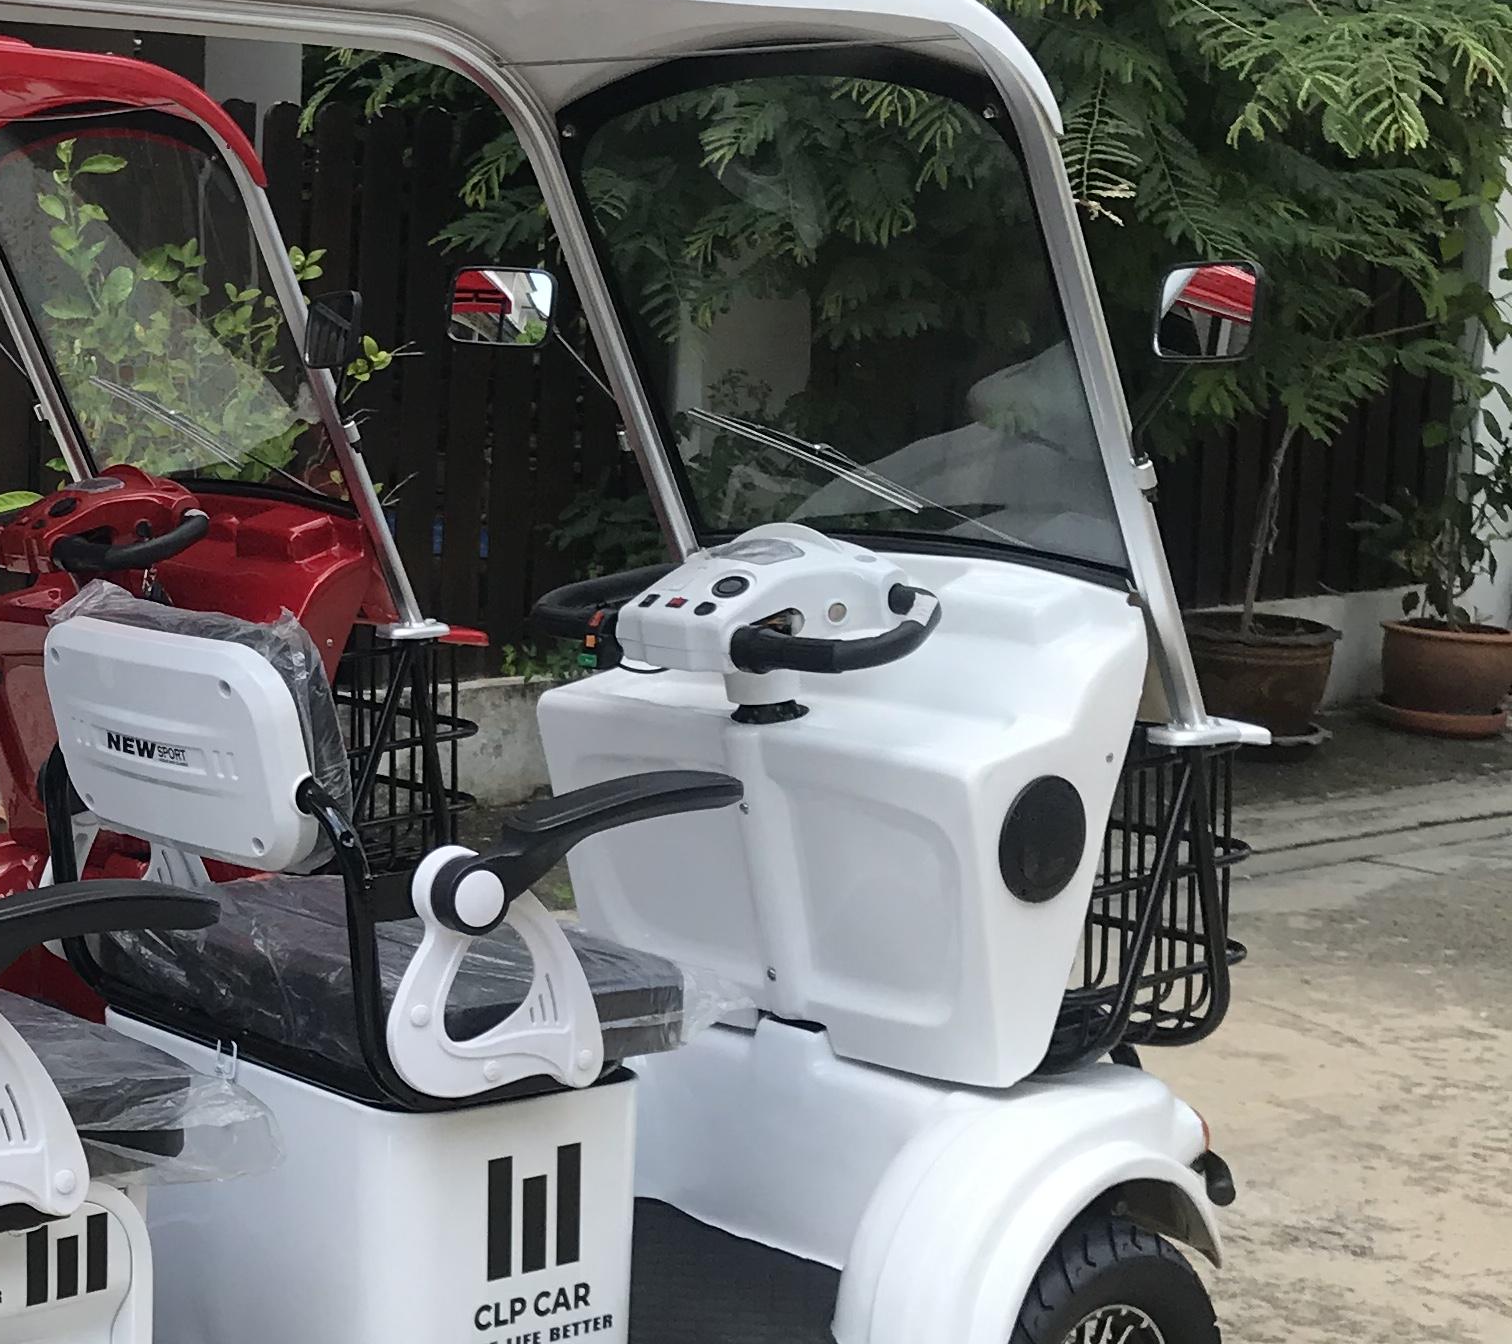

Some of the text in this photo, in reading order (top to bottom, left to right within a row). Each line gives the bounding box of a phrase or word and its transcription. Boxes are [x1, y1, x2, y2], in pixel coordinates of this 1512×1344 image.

[107, 732, 186, 761] NEW SPORT
[474, 1282, 590, 1331] CLP CAR
[549, 1314, 614, 1342] BETTER
